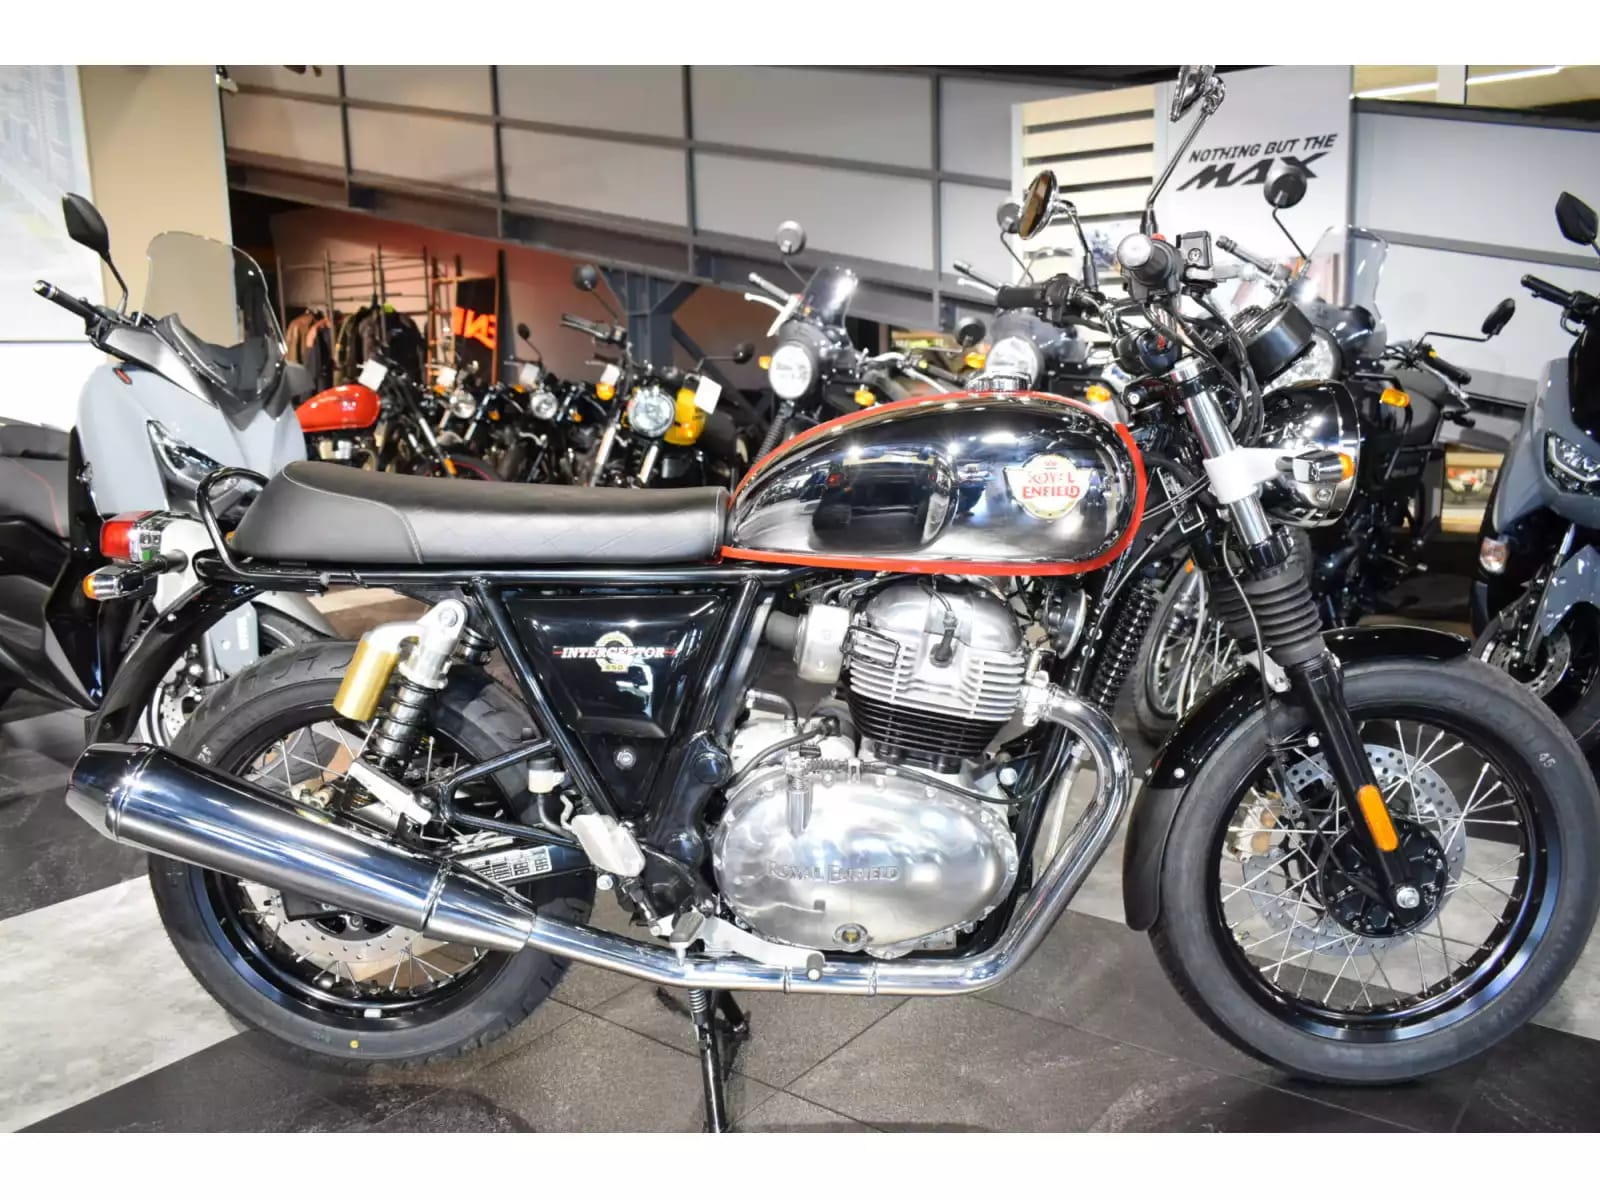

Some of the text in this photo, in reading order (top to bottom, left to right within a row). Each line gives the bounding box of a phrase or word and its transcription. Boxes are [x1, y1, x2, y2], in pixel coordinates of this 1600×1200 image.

[1188, 133, 1338, 163] NOTHING BUT THE
[1176, 152, 1329, 191] MAX
[561, 647, 665, 658] INTERCEPTOR
